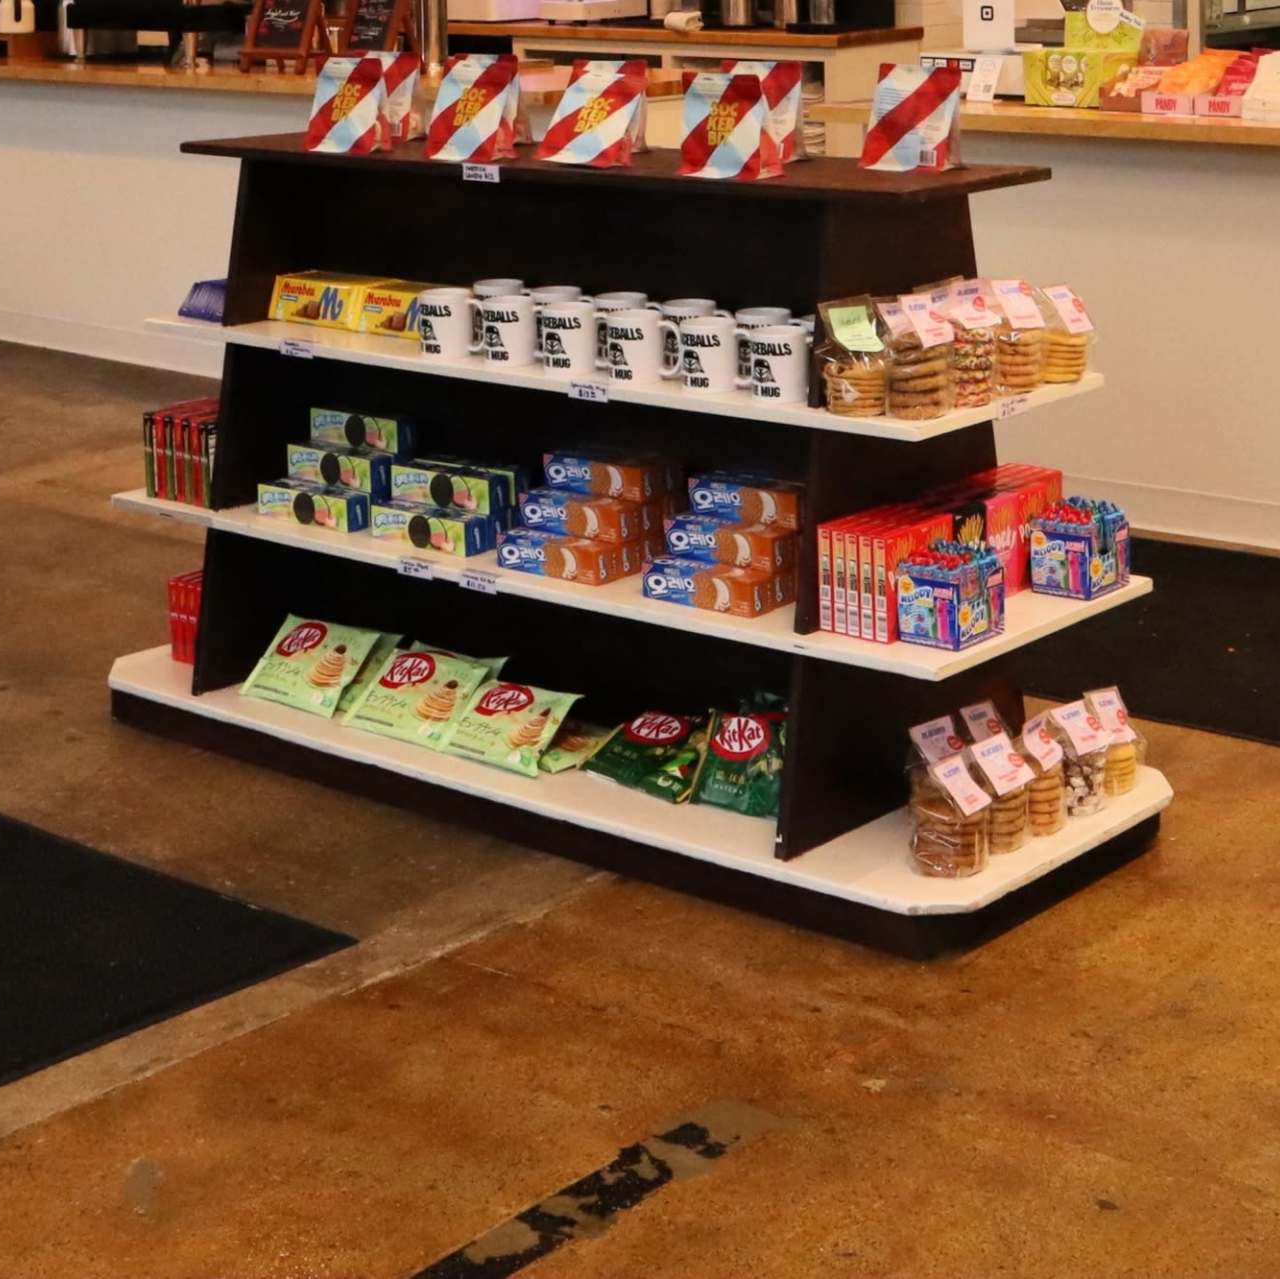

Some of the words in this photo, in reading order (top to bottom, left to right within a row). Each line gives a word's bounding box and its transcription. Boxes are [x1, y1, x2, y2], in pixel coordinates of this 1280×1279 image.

[425, 343, 441, 354] MUG
[491, 351, 509, 362] MUG
[552, 357, 571, 369] MUG
[614, 369, 633, 380] MUG
[689, 376, 709, 388] MUG
[760, 386, 781, 398] MUG
[634, 714, 681, 738] KitKat
[717, 717, 763, 752] KitKat
